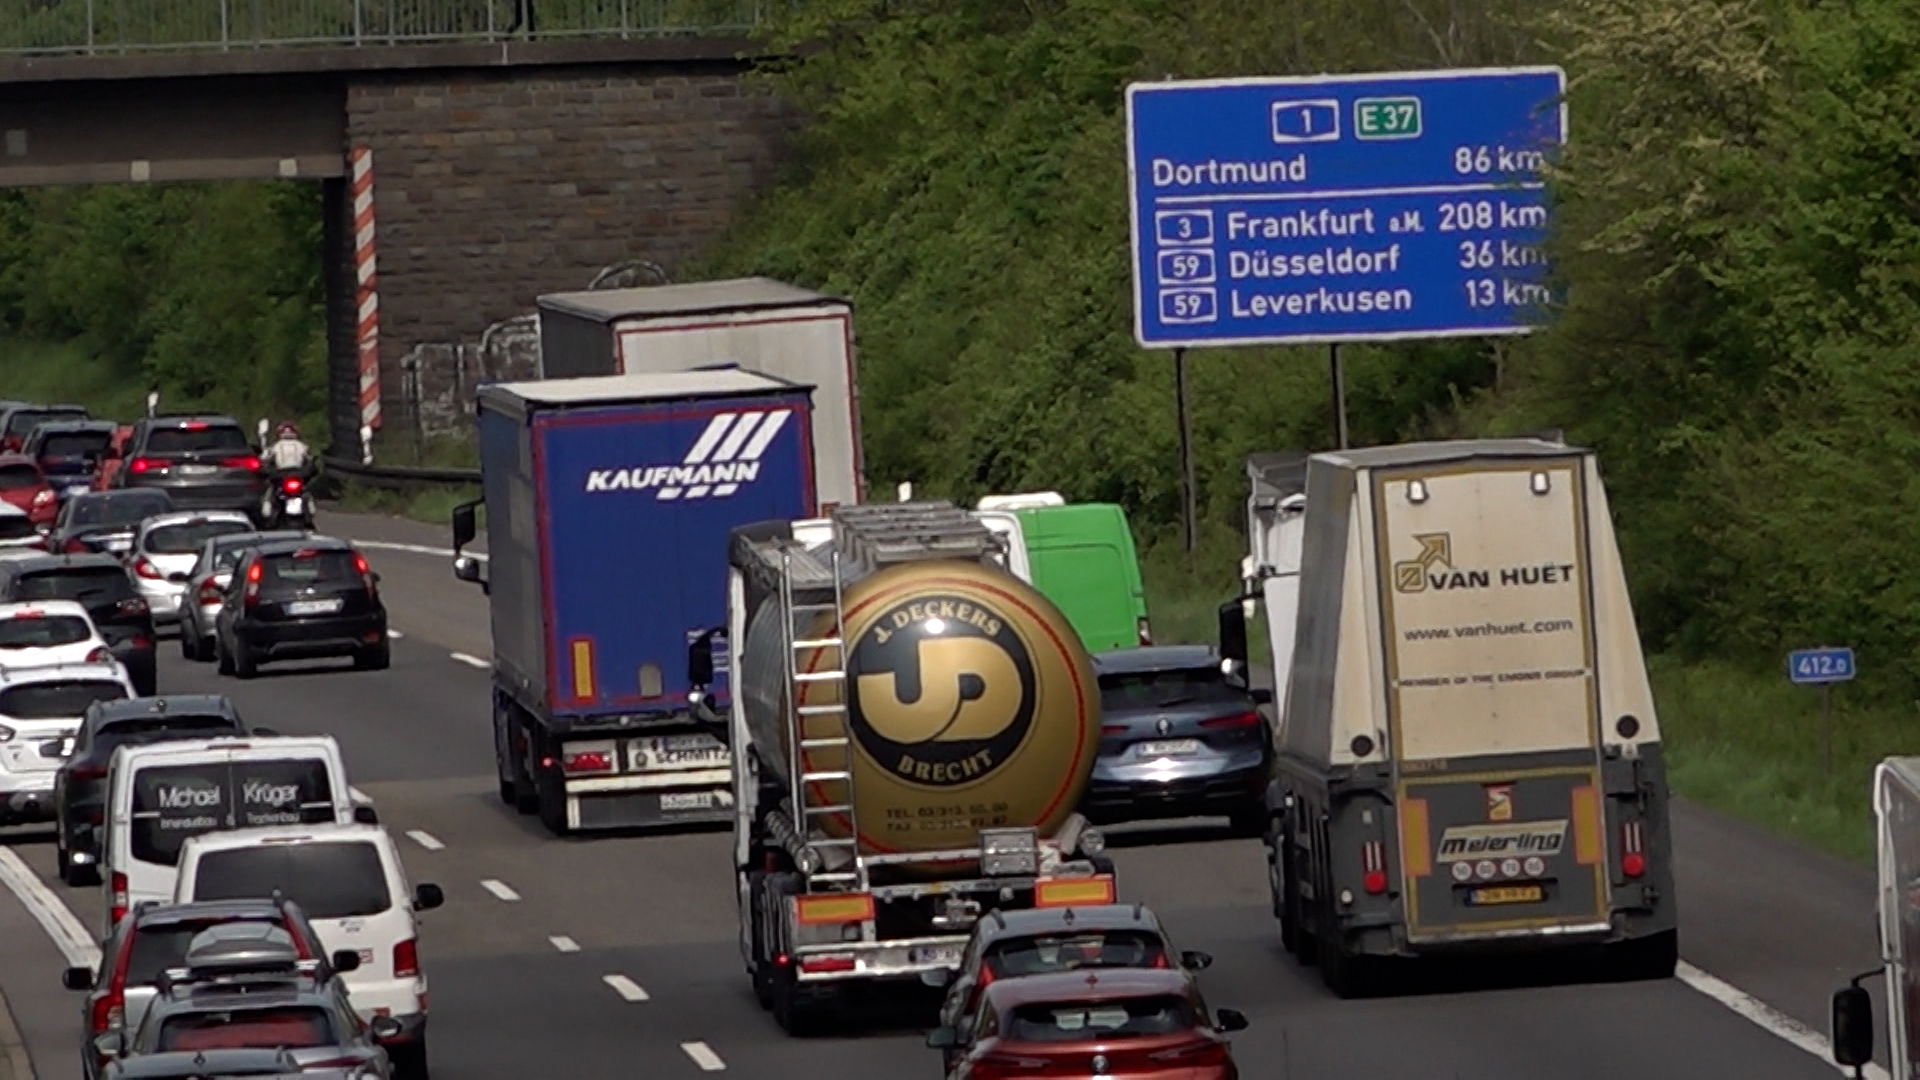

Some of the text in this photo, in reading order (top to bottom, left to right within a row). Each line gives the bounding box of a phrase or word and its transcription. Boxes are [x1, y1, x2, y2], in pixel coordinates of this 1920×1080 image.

[1301, 108, 1311, 133] 1
[1152, 145, 1545, 186] Dortmund 86 km
[1178, 217, 1191, 238] 3
[1227, 207, 1375, 240] Frankfurt
[1438, 201, 1493, 232] 208
[1500, 201, 1547, 228] km
[1173, 239, 1548, 279] 59 Düsseldorf 36 km
[1174, 278, 1549, 318] 59 Leverkusen 13 km
[586, 461, 760, 492] KAUFMANN
[1429, 569, 1490, 590] VAN
[893, 600, 1001, 638] DECKERS
[1403, 618, 1574, 642] www.vanhuet.com
[898, 749, 994, 782] BRECHT
[242, 781, 299, 807] Krüger
